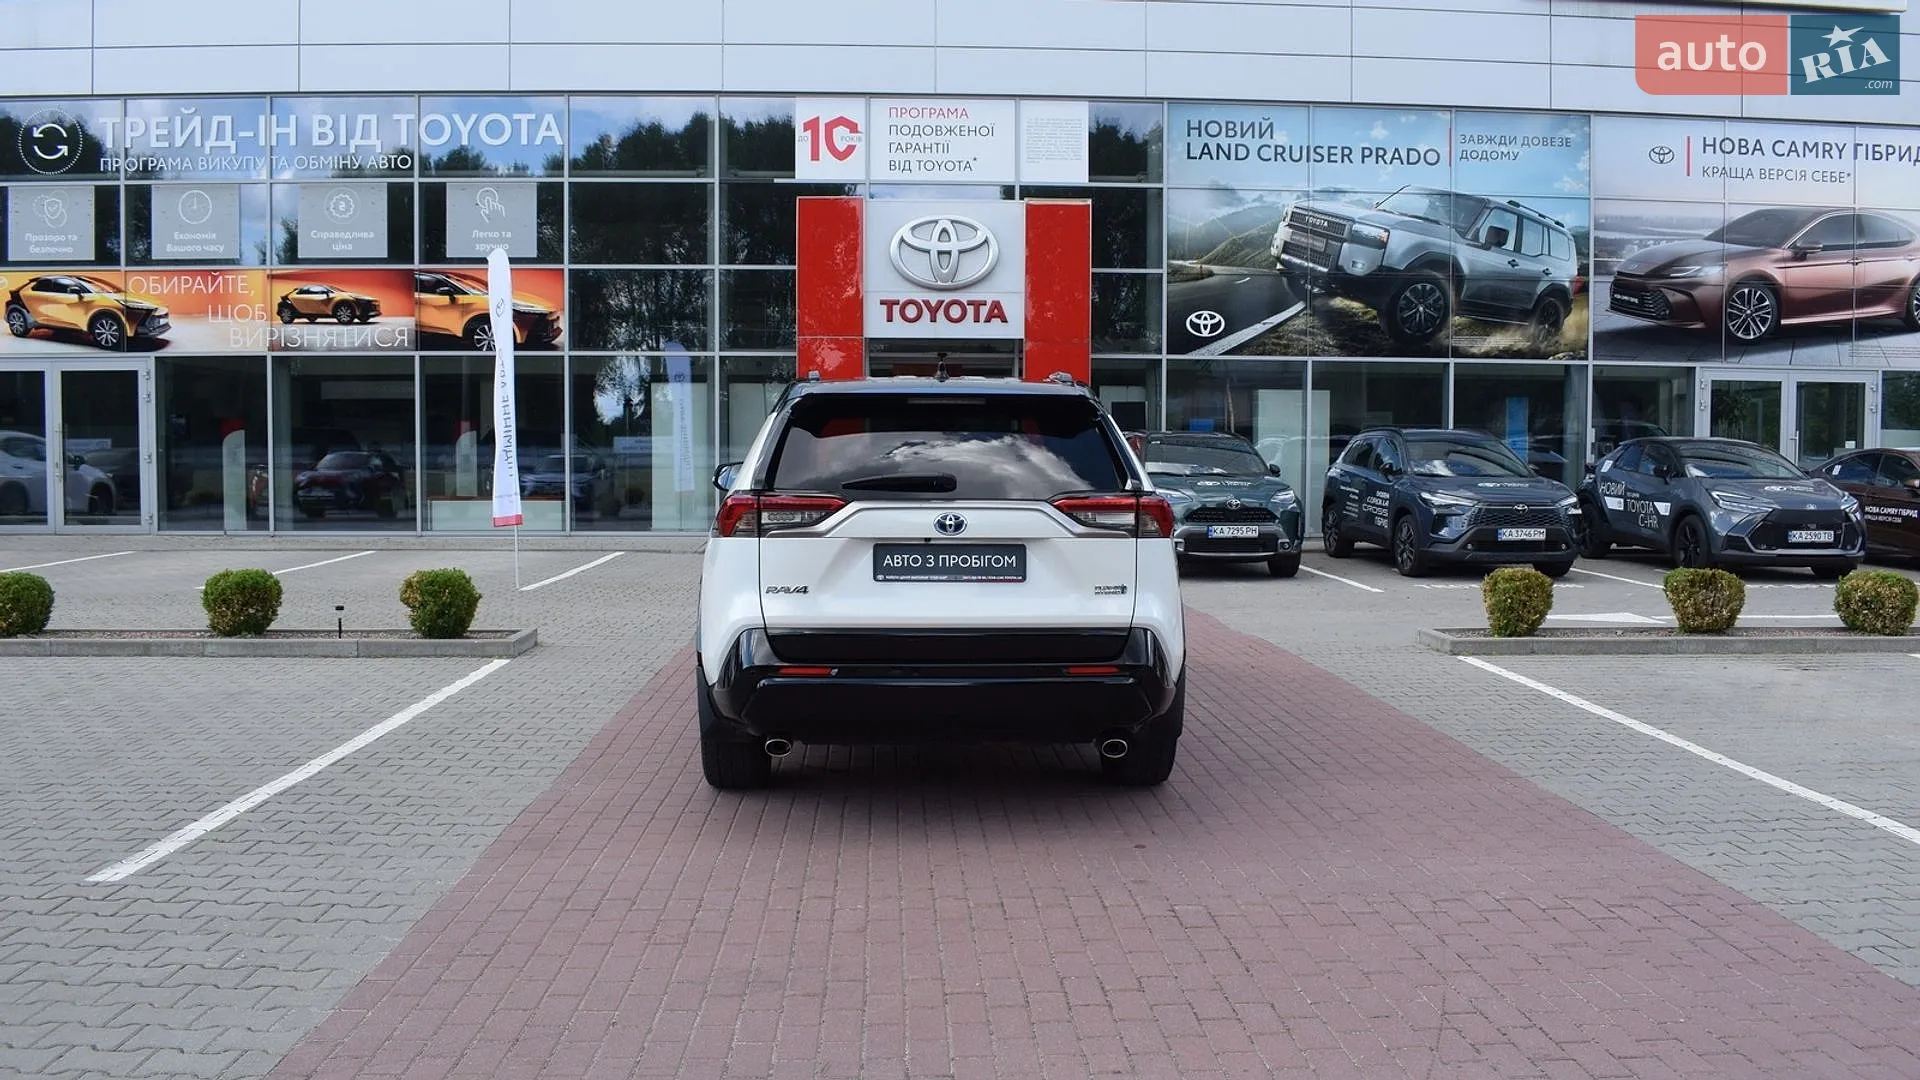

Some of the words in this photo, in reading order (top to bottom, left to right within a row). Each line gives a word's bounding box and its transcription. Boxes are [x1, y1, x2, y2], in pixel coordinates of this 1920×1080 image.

[889, 107, 969, 119] ПРОГРАМА
[99, 107, 297, 154] ТРЕЙД-ІН
[312, 114, 382, 153] ВІД
[392, 113, 564, 146] TOYOTA
[889, 122, 996, 138] ПОДОВЖЕНОЇ
[1187, 117, 1274, 140] НОВИЙ
[889, 140, 951, 154] ГАРАНТІЇ
[1459, 134, 1518, 147] ЗАВЖДИ
[1520, 136, 1572, 148] ДОВЕЗЕ
[1702, 136, 1765, 157] НОВА
[1772, 140, 1848, 160] CAMRY
[1187, 142, 1250, 161] LAND
[1257, 144, 1354, 164] CRUISER
[1361, 146, 1441, 167] PRADO
[1459, 149, 1520, 162] ДОДОМУ
[100, 156, 193, 173] ПРОГРАМА
[199, 156, 266, 172] ВИКУПУ
[270, 155, 290, 171] ТА
[294, 154, 363, 171] ОБМІНУ
[367, 154, 413, 169] АВТО
[889, 159, 913, 173] ВІД
[1702, 166, 1755, 181] КРАЩА
[1759, 168, 1807, 182] ВЕРСІЯ
[310, 230, 375, 241] Справедлива
[472, 230, 499, 240] Легко
[500, 231, 512, 239] та
[128, 271, 255, 296] ОБИРАЙТЕ,
[208, 304, 268, 324] ЩОБ
[880, 298, 1008, 323] TOYOTA
[230, 327, 409, 348] ВИРІЗНЯТИСЯ
[1626, 499, 1655, 514] TOYOTA
[1638, 513, 1659, 529] C-HR
[1213, 527, 1224, 536] KA
[1245, 527, 1257, 536] PH
[883, 554, 922, 568] АВТО
[939, 554, 1017, 568] ПРОБІГОМ
[765, 584, 809, 594] RAV4
